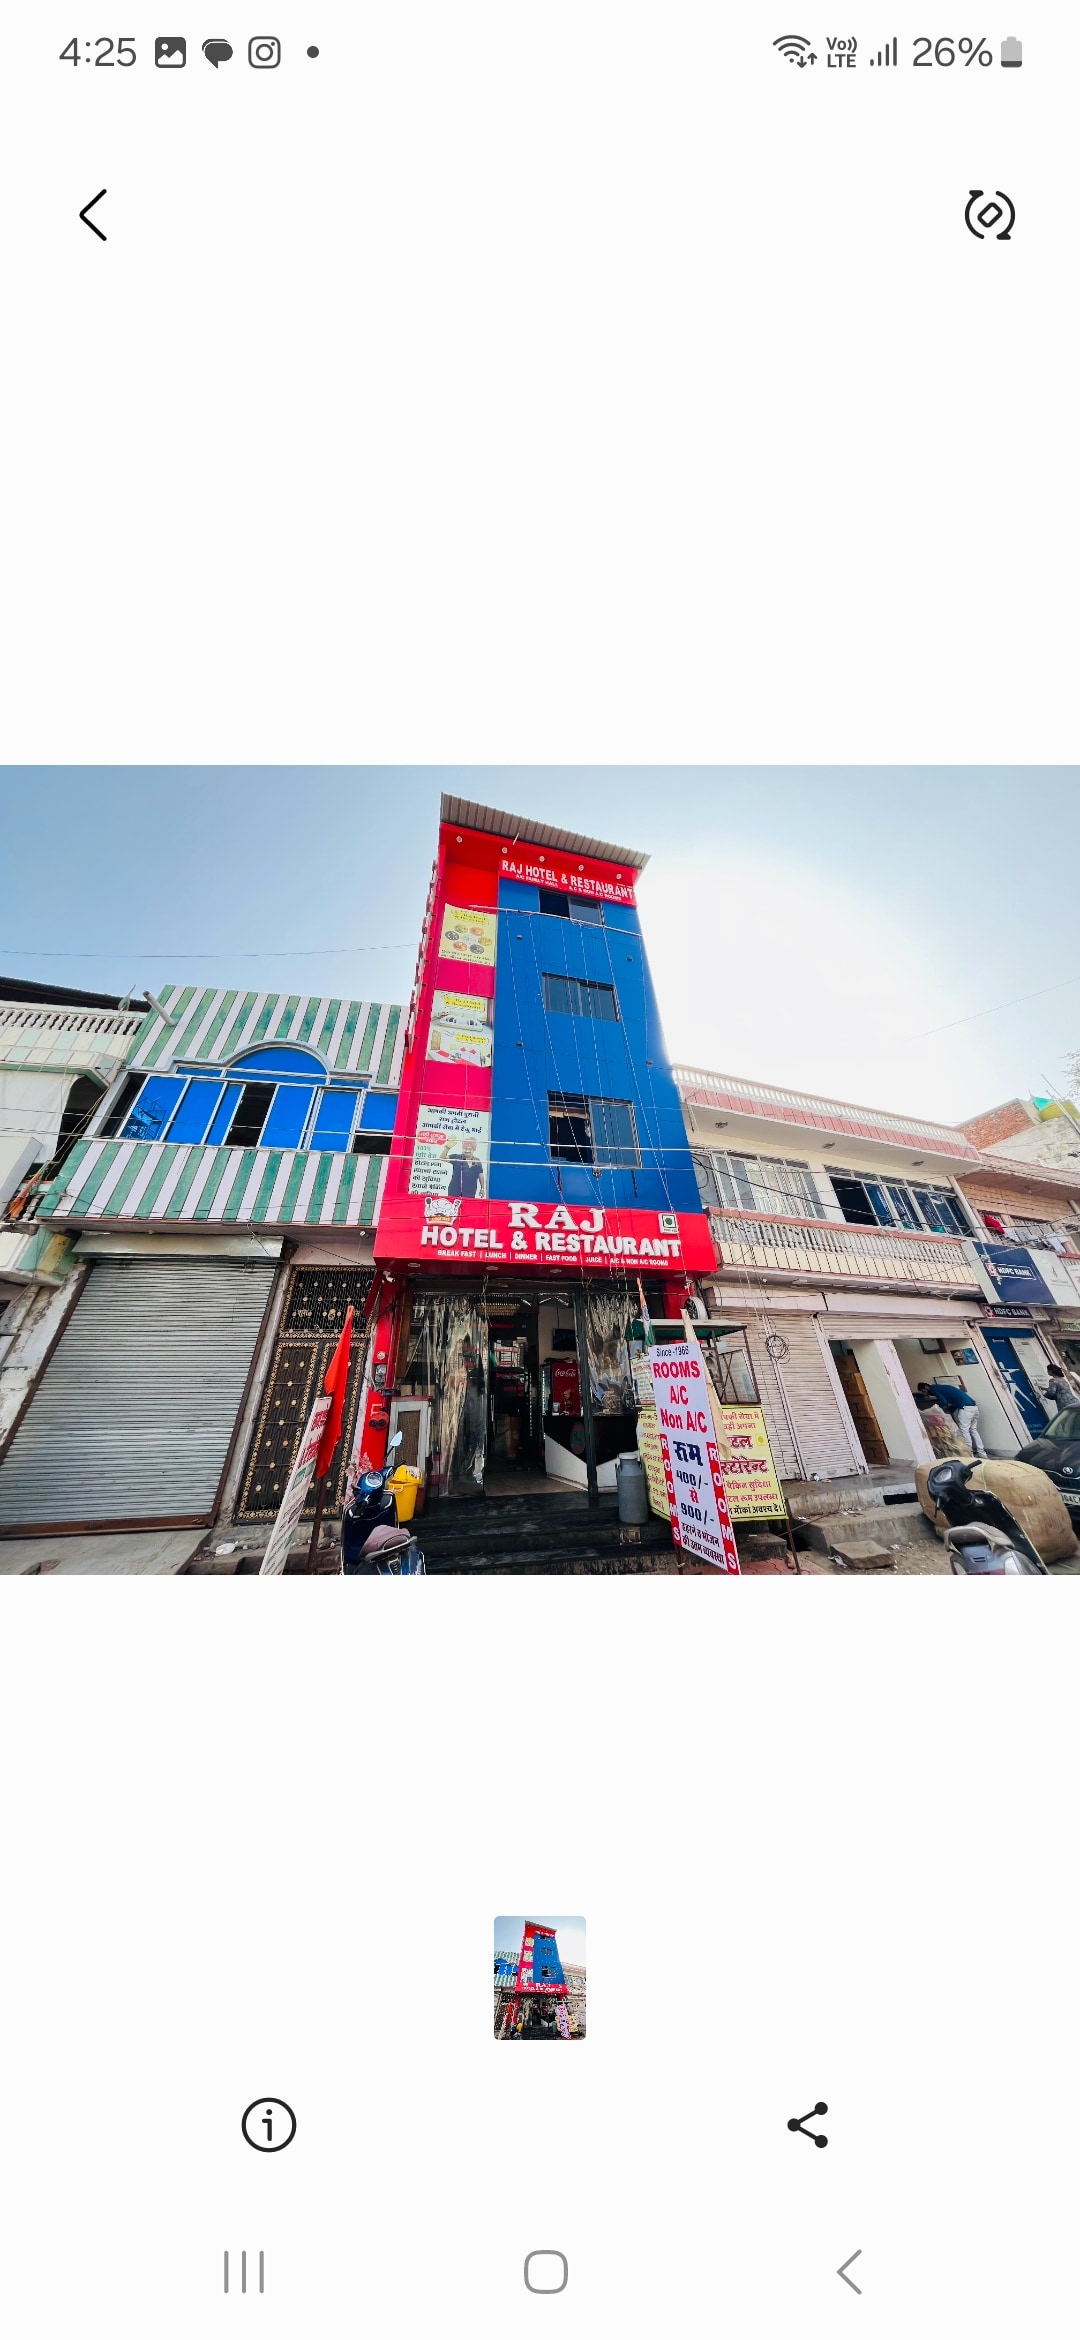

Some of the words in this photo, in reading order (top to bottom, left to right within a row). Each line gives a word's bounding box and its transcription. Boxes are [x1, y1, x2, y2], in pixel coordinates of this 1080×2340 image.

[59, 37, 135, 66] 4:25
[913, 36, 993, 67] 26%
[826, 54, 857, 67] LTE
[502, 860, 523, 874] RAJ
[526, 865, 558, 882] HOTEL
[561, 874, 569, 884] &
[570, 875, 633, 899] RESTAURANT
[507, 1202, 606, 1233] RAJ
[421, 1226, 503, 1249] HOTEL
[511, 1231, 528, 1251] &
[535, 1232, 682, 1258] RESTAURANT
[998, 1266, 1015, 1275] HDFC
[1015, 1268, 1032, 1277] BANK
[993, 1307, 1012, 1315] HDFC
[1011, 1308, 1031, 1316] BANK
[653, 1361, 700, 1378] ROOMS
[670, 1385, 689, 1405] A/C
[660, 1408, 683, 1429] Non
[686, 1411, 708, 1433] A/C
[727, 1435, 753, 1449] टल
